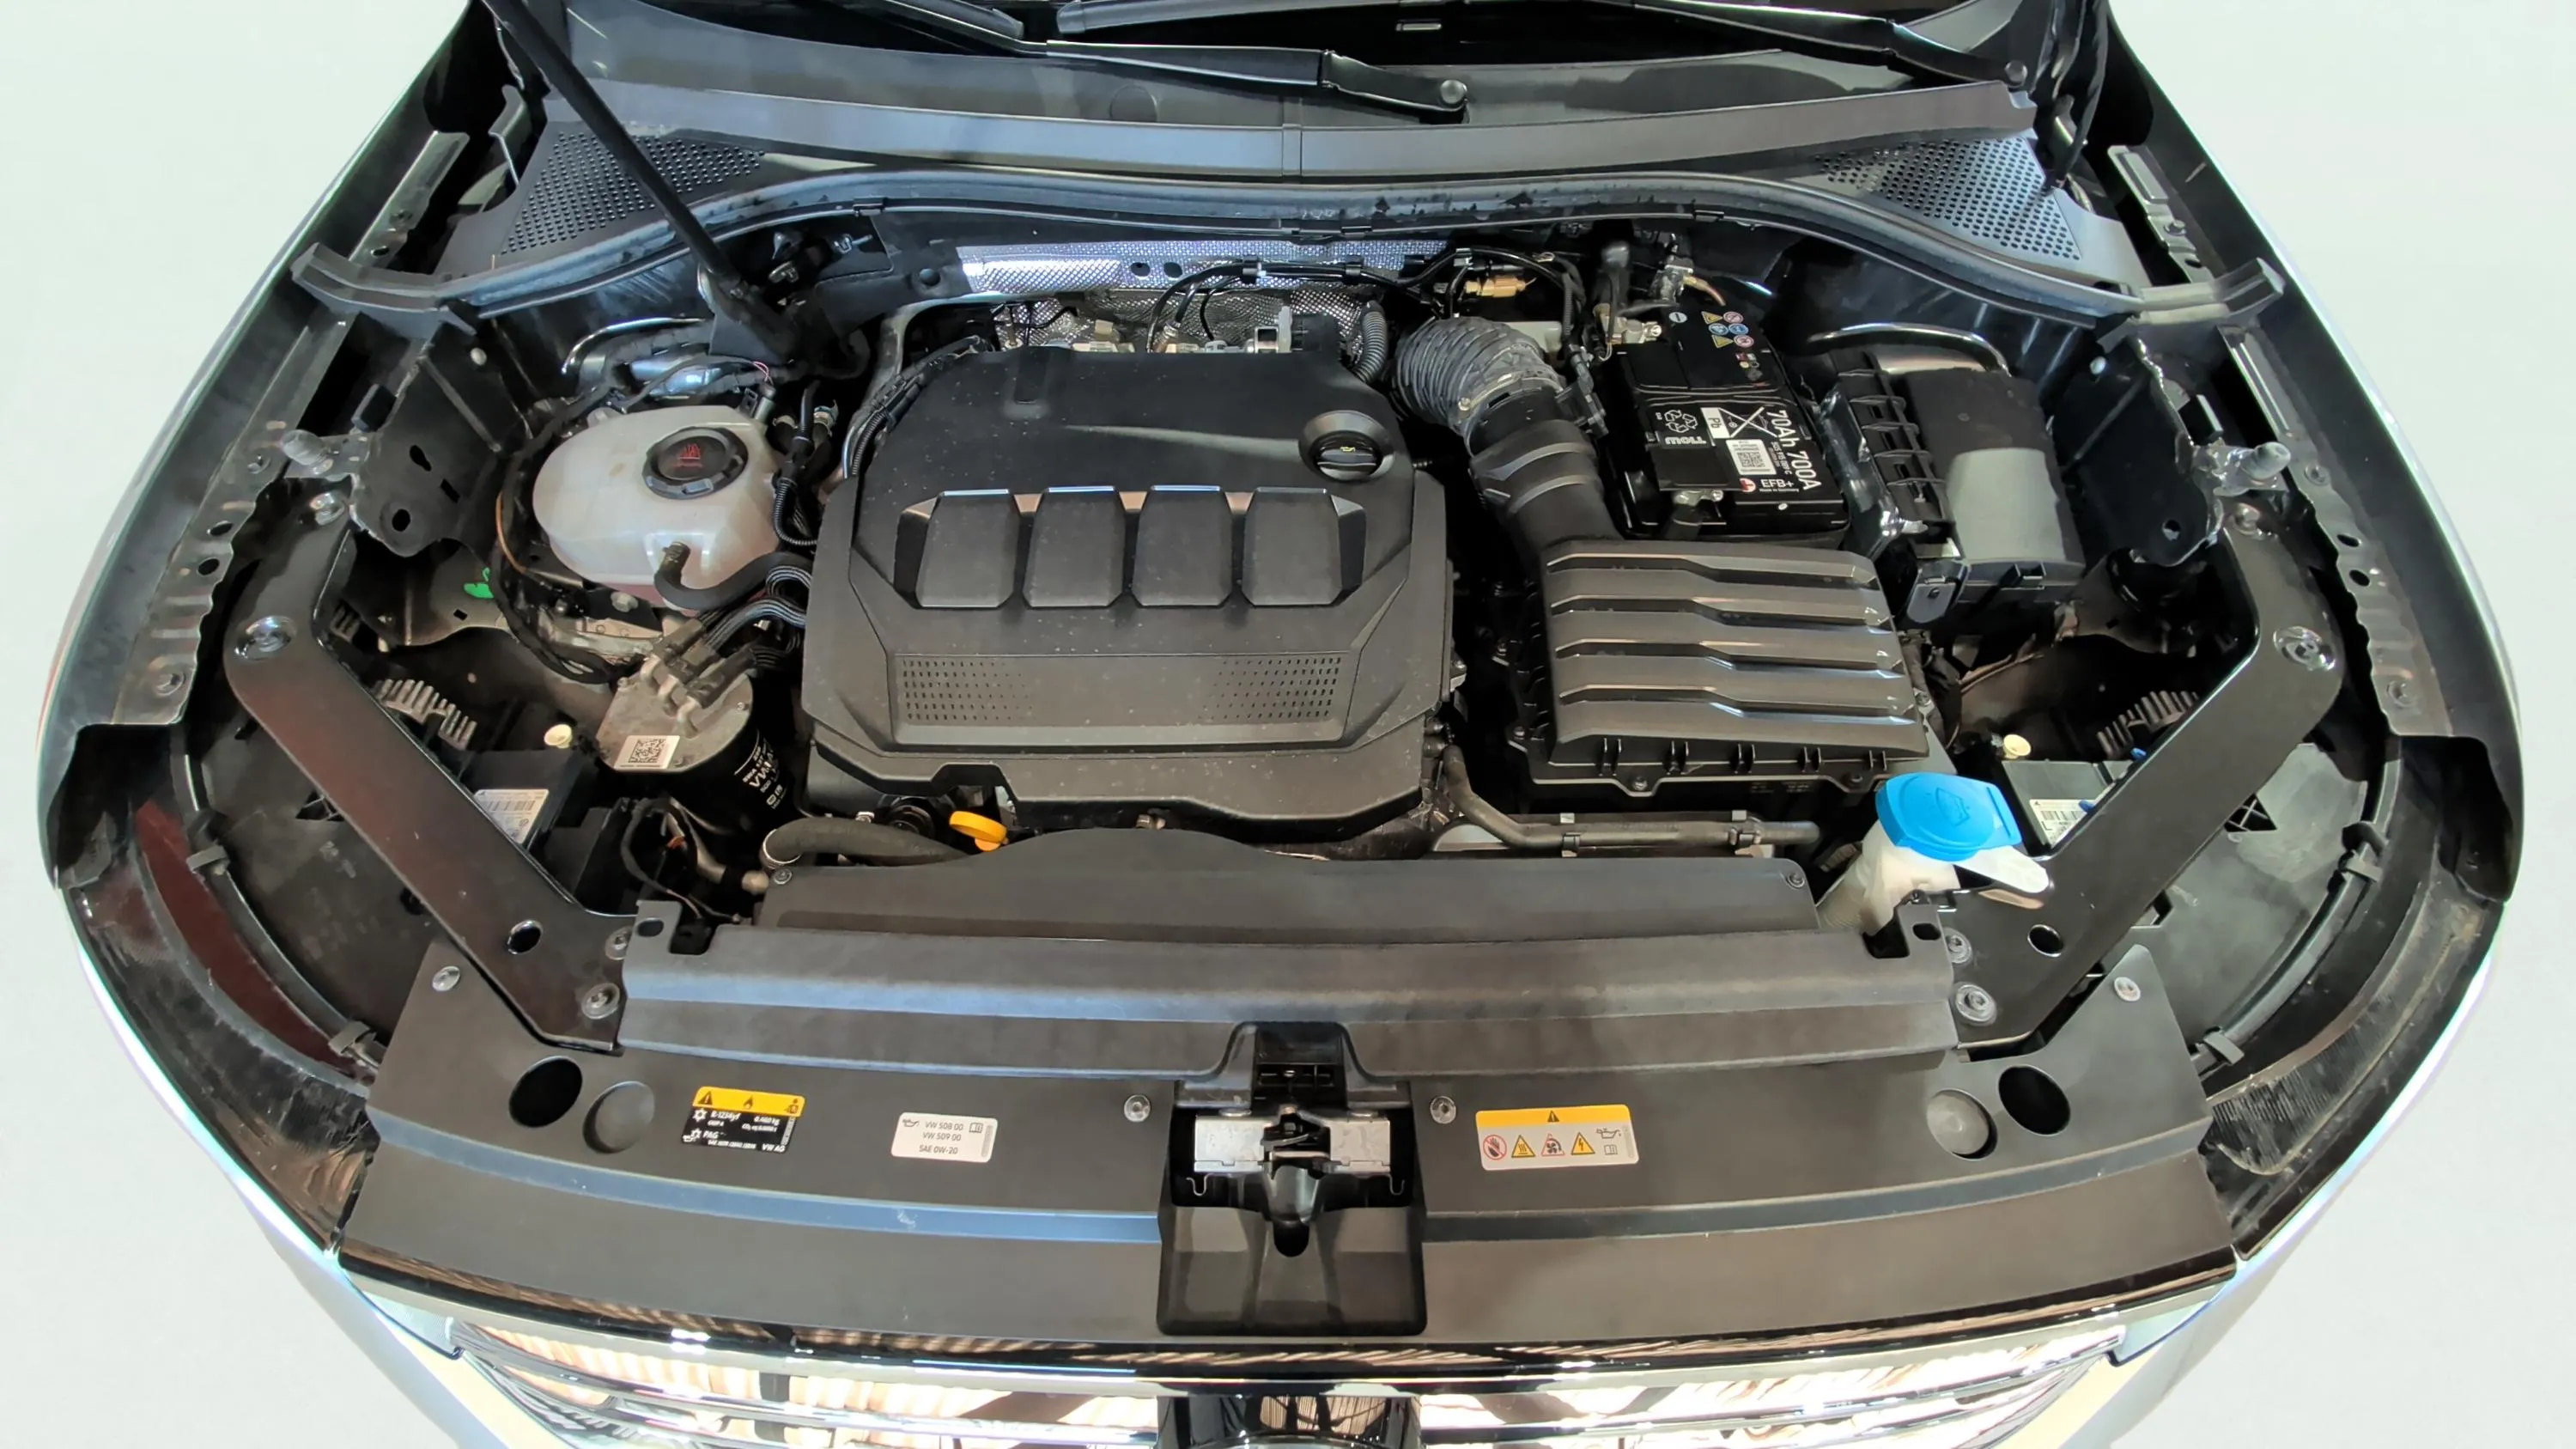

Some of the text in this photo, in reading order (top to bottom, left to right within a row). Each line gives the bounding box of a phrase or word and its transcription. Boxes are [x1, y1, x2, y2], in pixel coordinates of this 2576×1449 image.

[1766, 410, 1822, 490] 70Ah 700A
[1760, 478, 1794, 488] EFB+
[939, 1122, 953, 1130] 508
[953, 1123, 964, 1131] 00
[702, 1130, 719, 1139] PAG
[936, 1132, 950, 1141] 509
[951, 1133, 962, 1142] 00
[919, 1144, 959, 1155] SAE 0W-20
